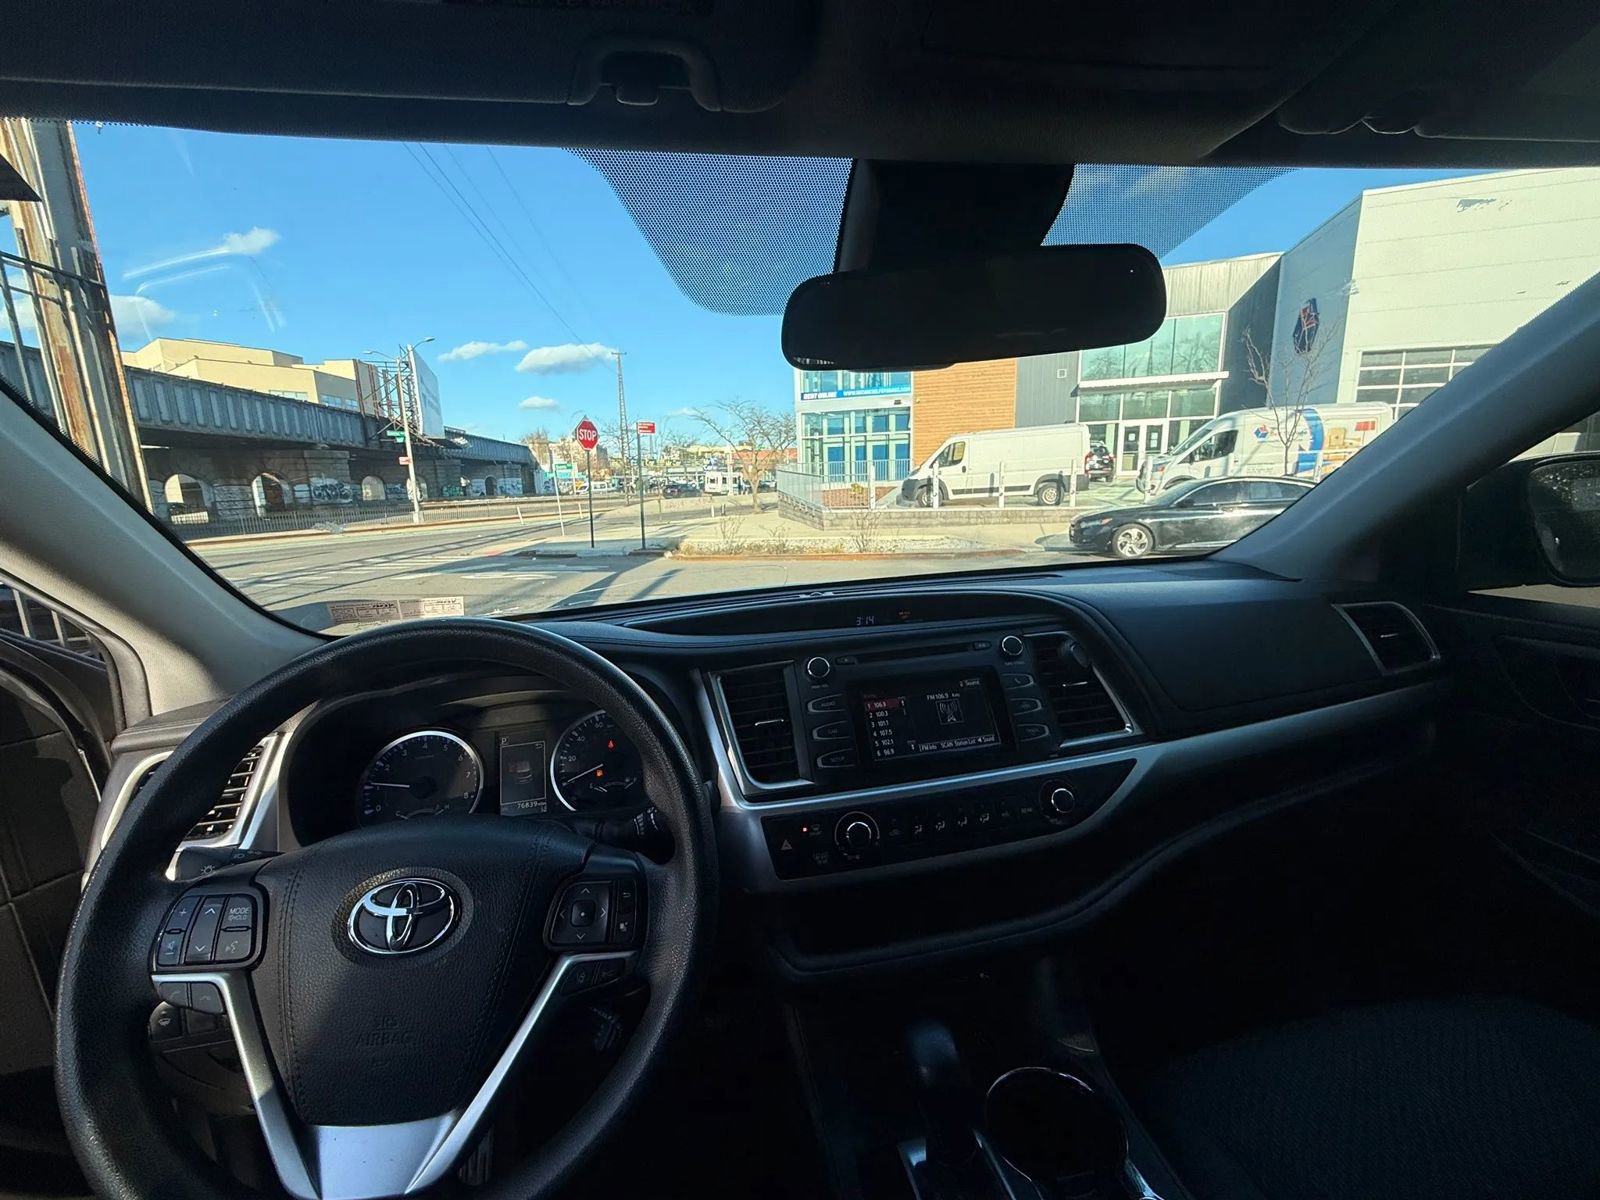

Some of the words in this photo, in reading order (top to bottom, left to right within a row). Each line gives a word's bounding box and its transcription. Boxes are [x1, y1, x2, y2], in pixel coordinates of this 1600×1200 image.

[579, 429, 597, 441] STOP
[856, 616, 875, 625] 3:14
[577, 735, 586, 743] 40
[230, 907, 250, 915] MODE
[355, 1031, 413, 1047] AIRBAG
